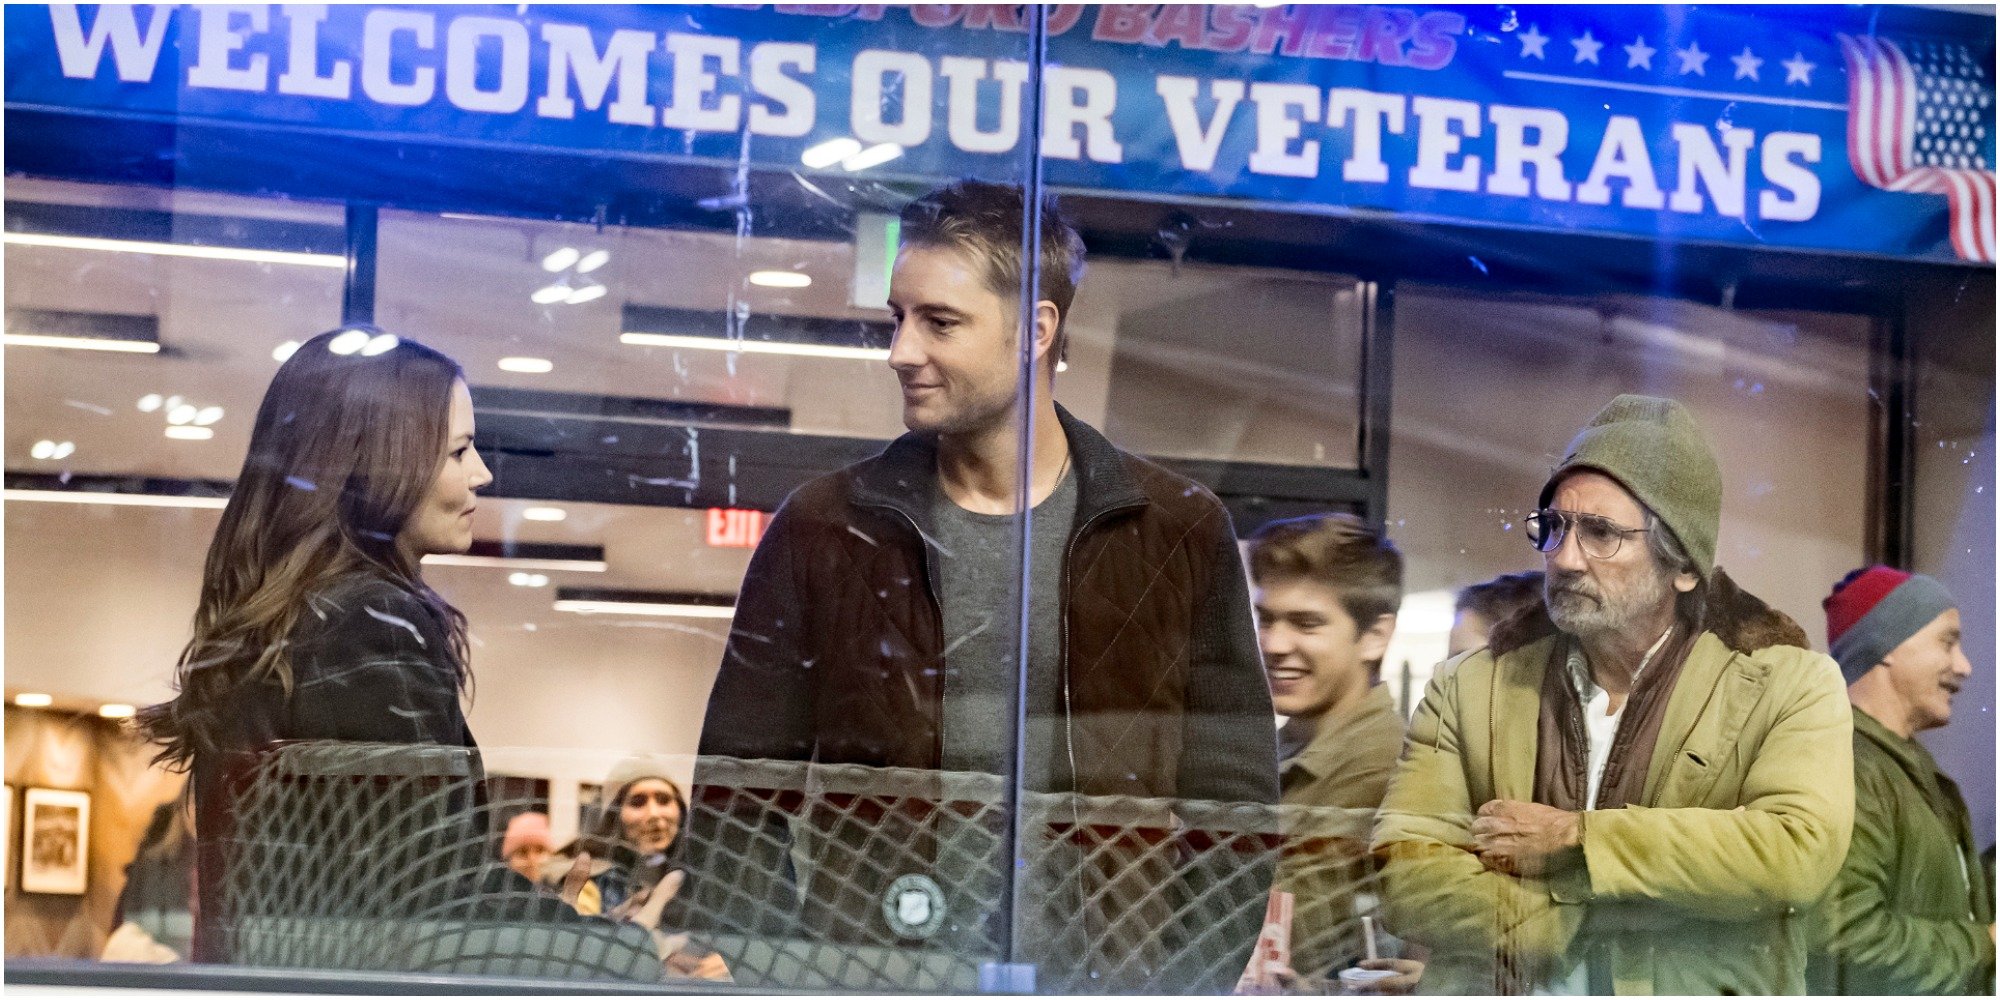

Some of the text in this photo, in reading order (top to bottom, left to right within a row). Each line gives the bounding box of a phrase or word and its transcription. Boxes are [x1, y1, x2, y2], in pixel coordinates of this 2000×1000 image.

[1091, 4, 1460, 70] BASHERS
[46, 4, 1822, 221] WELCOMES OUR VETERANS
